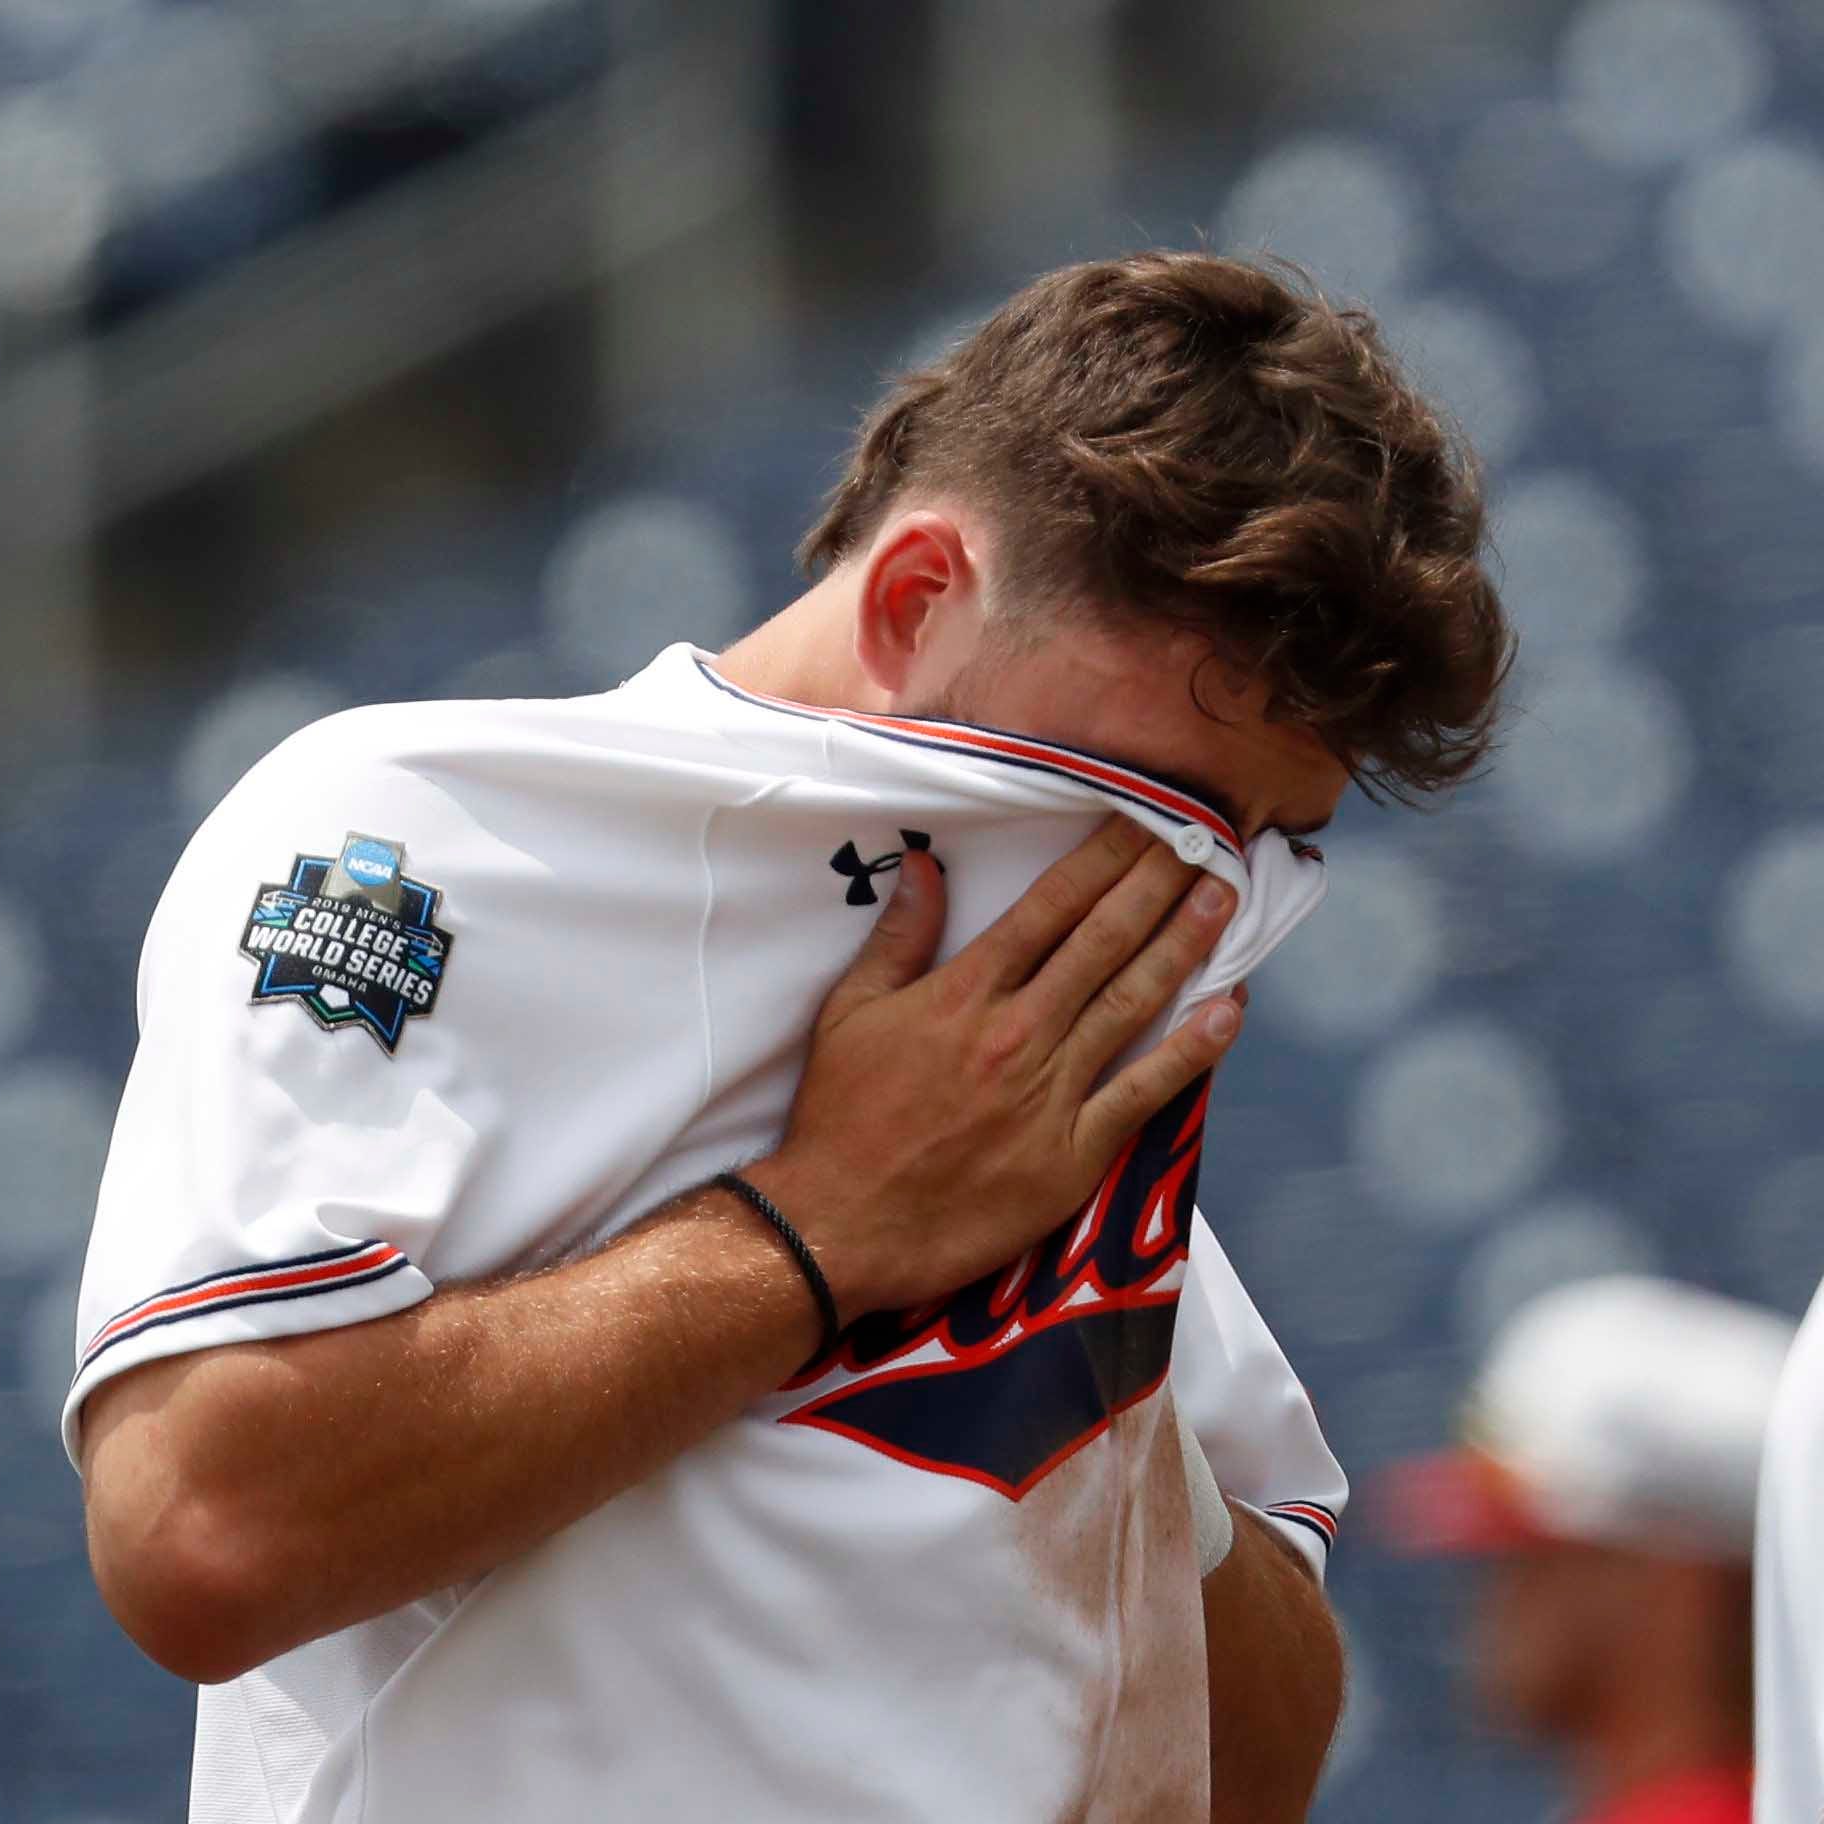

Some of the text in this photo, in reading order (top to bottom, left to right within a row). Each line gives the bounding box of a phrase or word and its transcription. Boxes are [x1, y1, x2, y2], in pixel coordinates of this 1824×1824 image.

[347, 857, 393, 880] NCAA
[293, 907, 409, 963] COLLEGE
[247, 925, 434, 1005] WORLD SERIES
[311, 964, 367, 993] OMAHA
